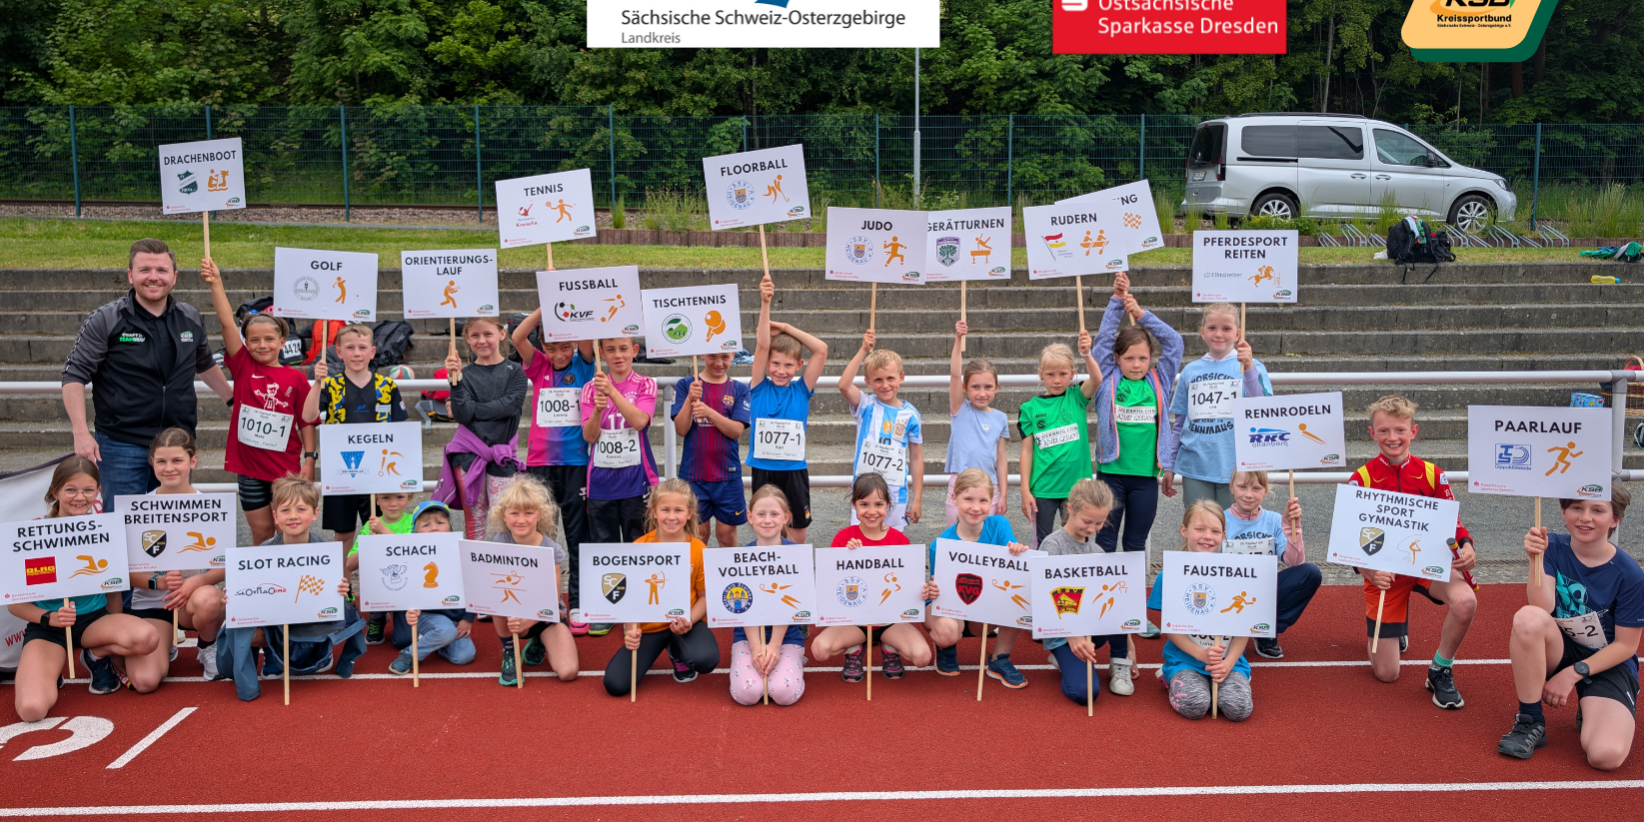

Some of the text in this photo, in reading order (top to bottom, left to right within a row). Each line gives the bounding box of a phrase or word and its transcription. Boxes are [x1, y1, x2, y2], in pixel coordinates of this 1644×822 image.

[164, 150, 237, 166] DRACHENBOOT
[720, 158, 788, 176] FLOORBALL
[524, 184, 564, 198] TENNIS
[861, 220, 893, 231] JUDO
[1050, 212, 1098, 226] RUDERN
[1203, 236, 1288, 248] PFERDESPORT
[405, 255, 493, 266] ORIENTIERUNGS-
[1224, 250, 1266, 260] REITEN
[310, 260, 343, 272] GOLF
[436, 266, 462, 276] LAUF
[558, 278, 618, 292] FUSSBALL
[652, 294, 726, 308] TISCHTENNIS
[1192, 391, 1236, 406] 1047-1
[540, 400, 581, 412] 1008-1
[1245, 404, 1331, 419] RENNRODELN
[241, 416, 286, 438] 1010-1
[1494, 420, 1582, 434] PAARLAUF
[348, 434, 394, 444] KEGELN
[758, 430, 801, 446] 1077-1
[596, 439, 637, 454] 1008-2
[862, 451, 904, 472] 1077-2
[131, 499, 222, 511] SCHWIMMEN
[1356, 490, 1438, 510] RHYTHMISCHE
[124, 512, 228, 524] BREITENSPORT
[1376, 504, 1415, 518] SPORT
[18, 520, 102, 538] RETTUNGS-
[1358, 513, 1430, 532] GYMNASTIK
[12, 532, 110, 552] SCHWIMMEN
[386, 545, 436, 556] SCHACH
[734, 551, 781, 563] BEACH-
[238, 555, 330, 571] SLOT RACING
[470, 552, 538, 568] BADMINTON
[592, 555, 681, 566] BOGENSPORT
[836, 558, 904, 571] HANDBALL
[948, 551, 1030, 572] VOLLEYBALL
[718, 564, 799, 578] VOLLEYBALL
[1045, 565, 1128, 580] BASKETBALL
[1184, 564, 1258, 578] FAUSTBALL
[604, 575, 617, 588] SC
[612, 590, 620, 600] F
